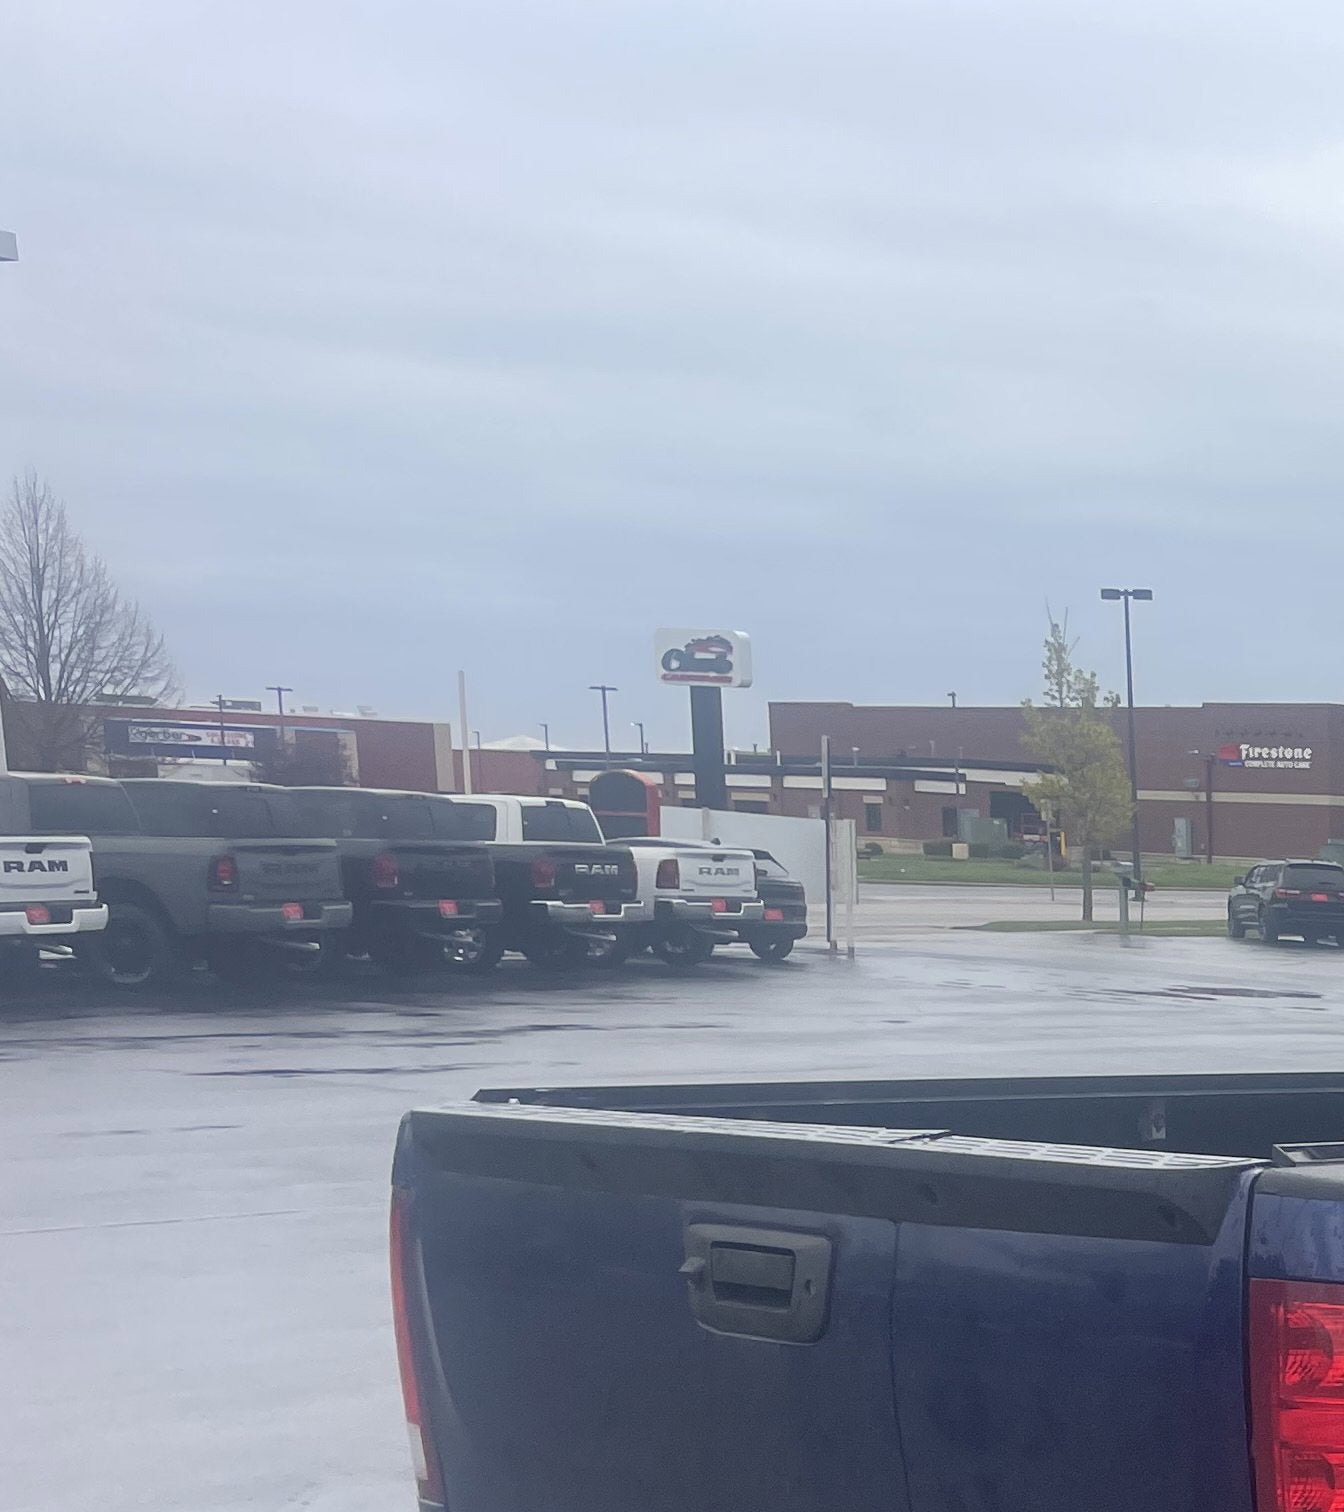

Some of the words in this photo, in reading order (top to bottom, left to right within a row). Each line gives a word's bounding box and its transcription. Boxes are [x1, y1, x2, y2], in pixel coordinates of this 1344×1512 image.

[1240, 743, 1312, 760] Firestone
[3, 860, 69, 873] RAM
[574, 864, 619, 876] RAM
[698, 866, 740, 877] RAM
